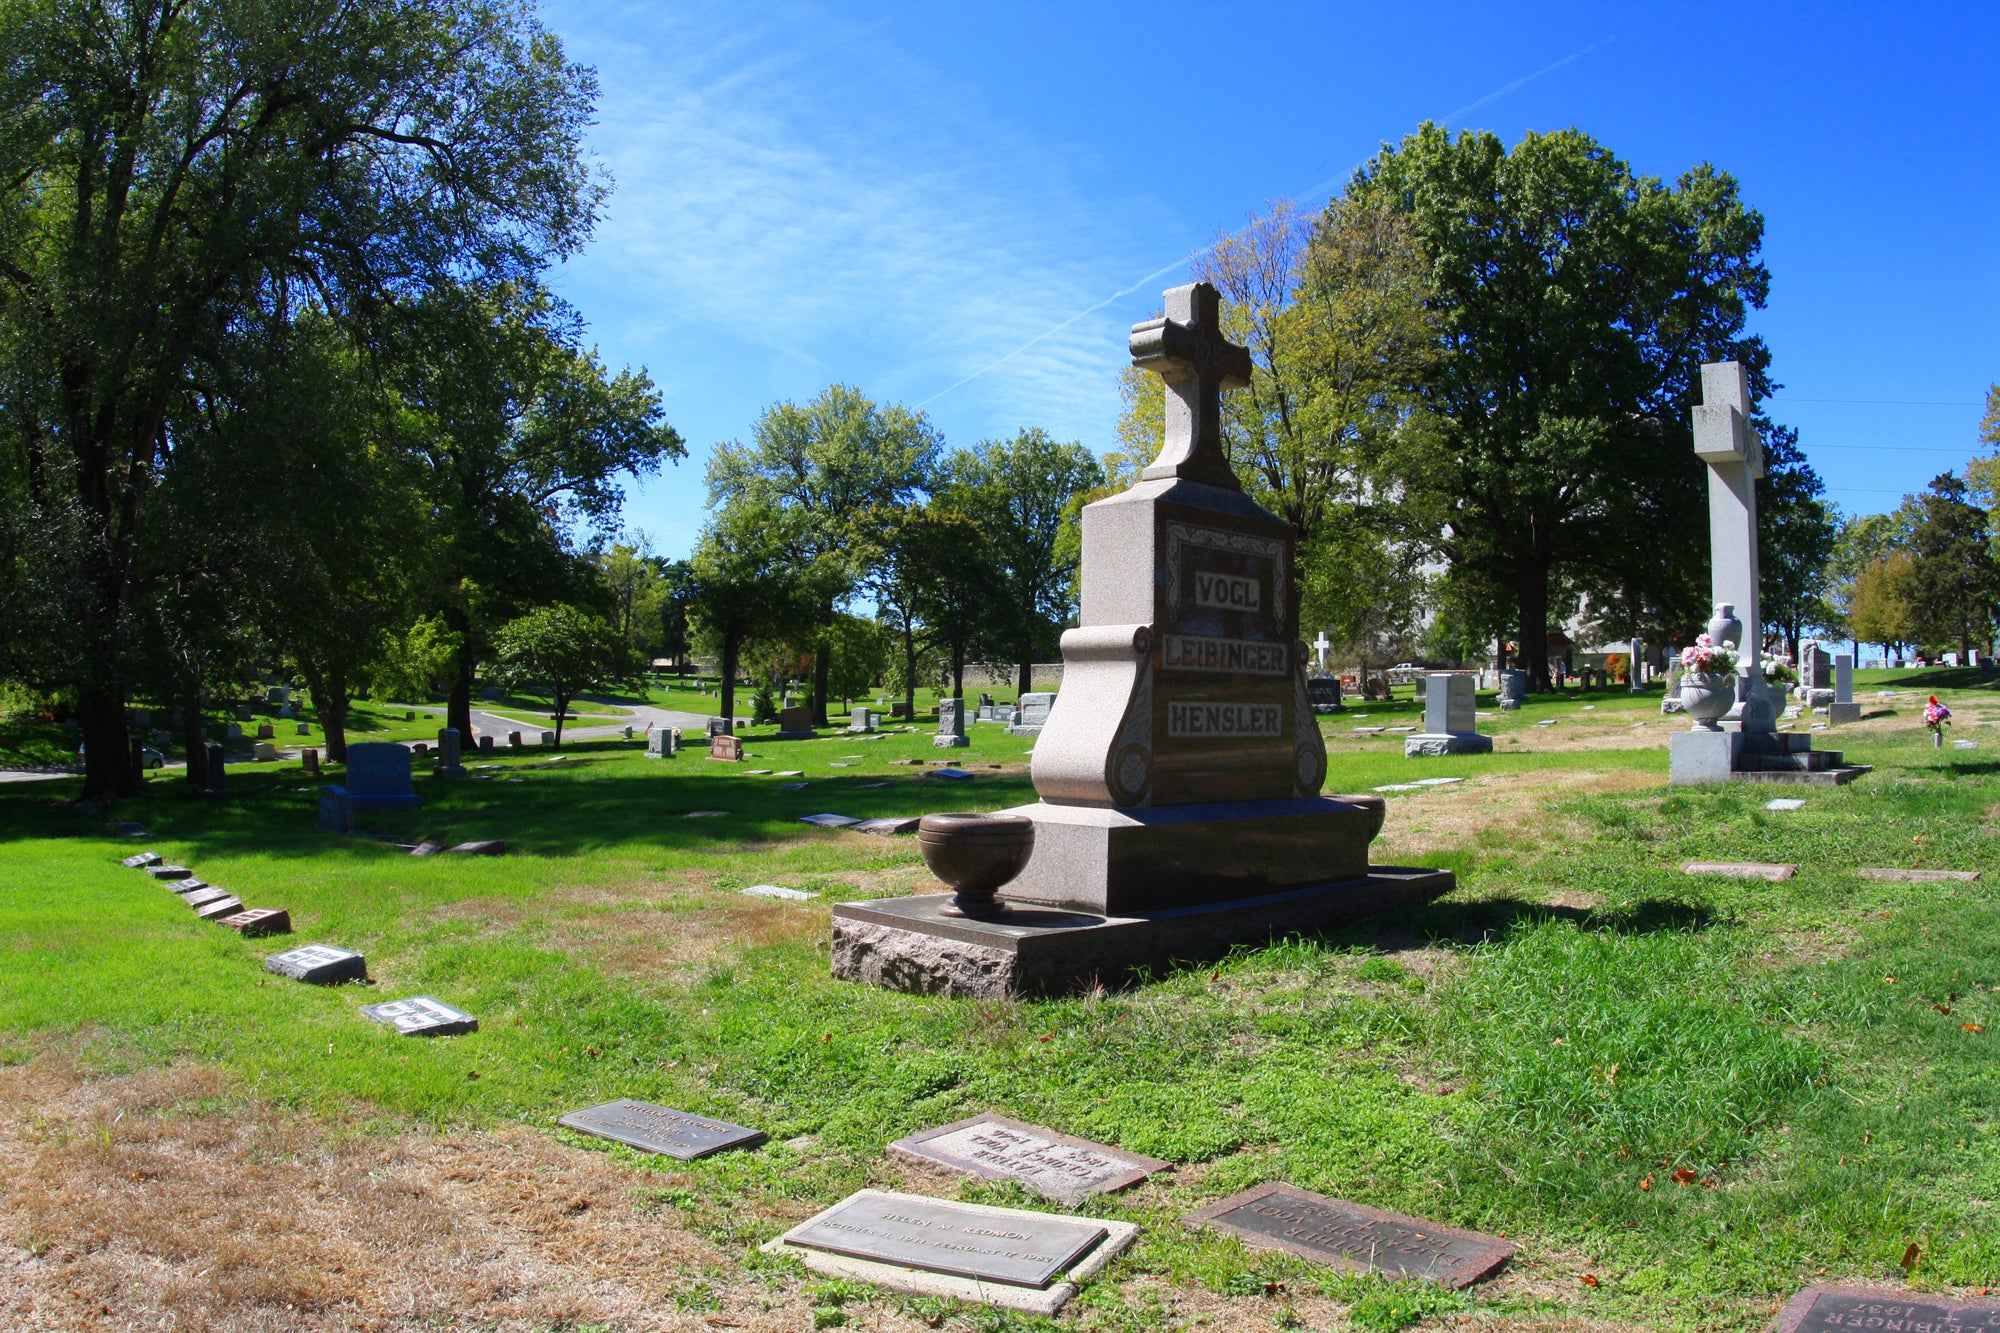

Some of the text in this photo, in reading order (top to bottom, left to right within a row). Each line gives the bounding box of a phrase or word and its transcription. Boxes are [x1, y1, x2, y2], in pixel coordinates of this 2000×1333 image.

[1198, 576, 1258, 607] VOGL
[1166, 639, 1285, 671] LEIBINGER
[1172, 706, 1279, 732] HENSLER
[973, 1149, 1044, 1174] FATHER
[1020, 1150, 1092, 1177] GEORGE
[820, 1220, 876, 1236] OCTOBER
[882, 1213, 932, 1228] HELEN
[962, 1226, 1032, 1241] REDMON
[1254, 1204, 1464, 1265] ELIZABETH VOGL
[1284, 1228, 1382, 1258] MOTHER
